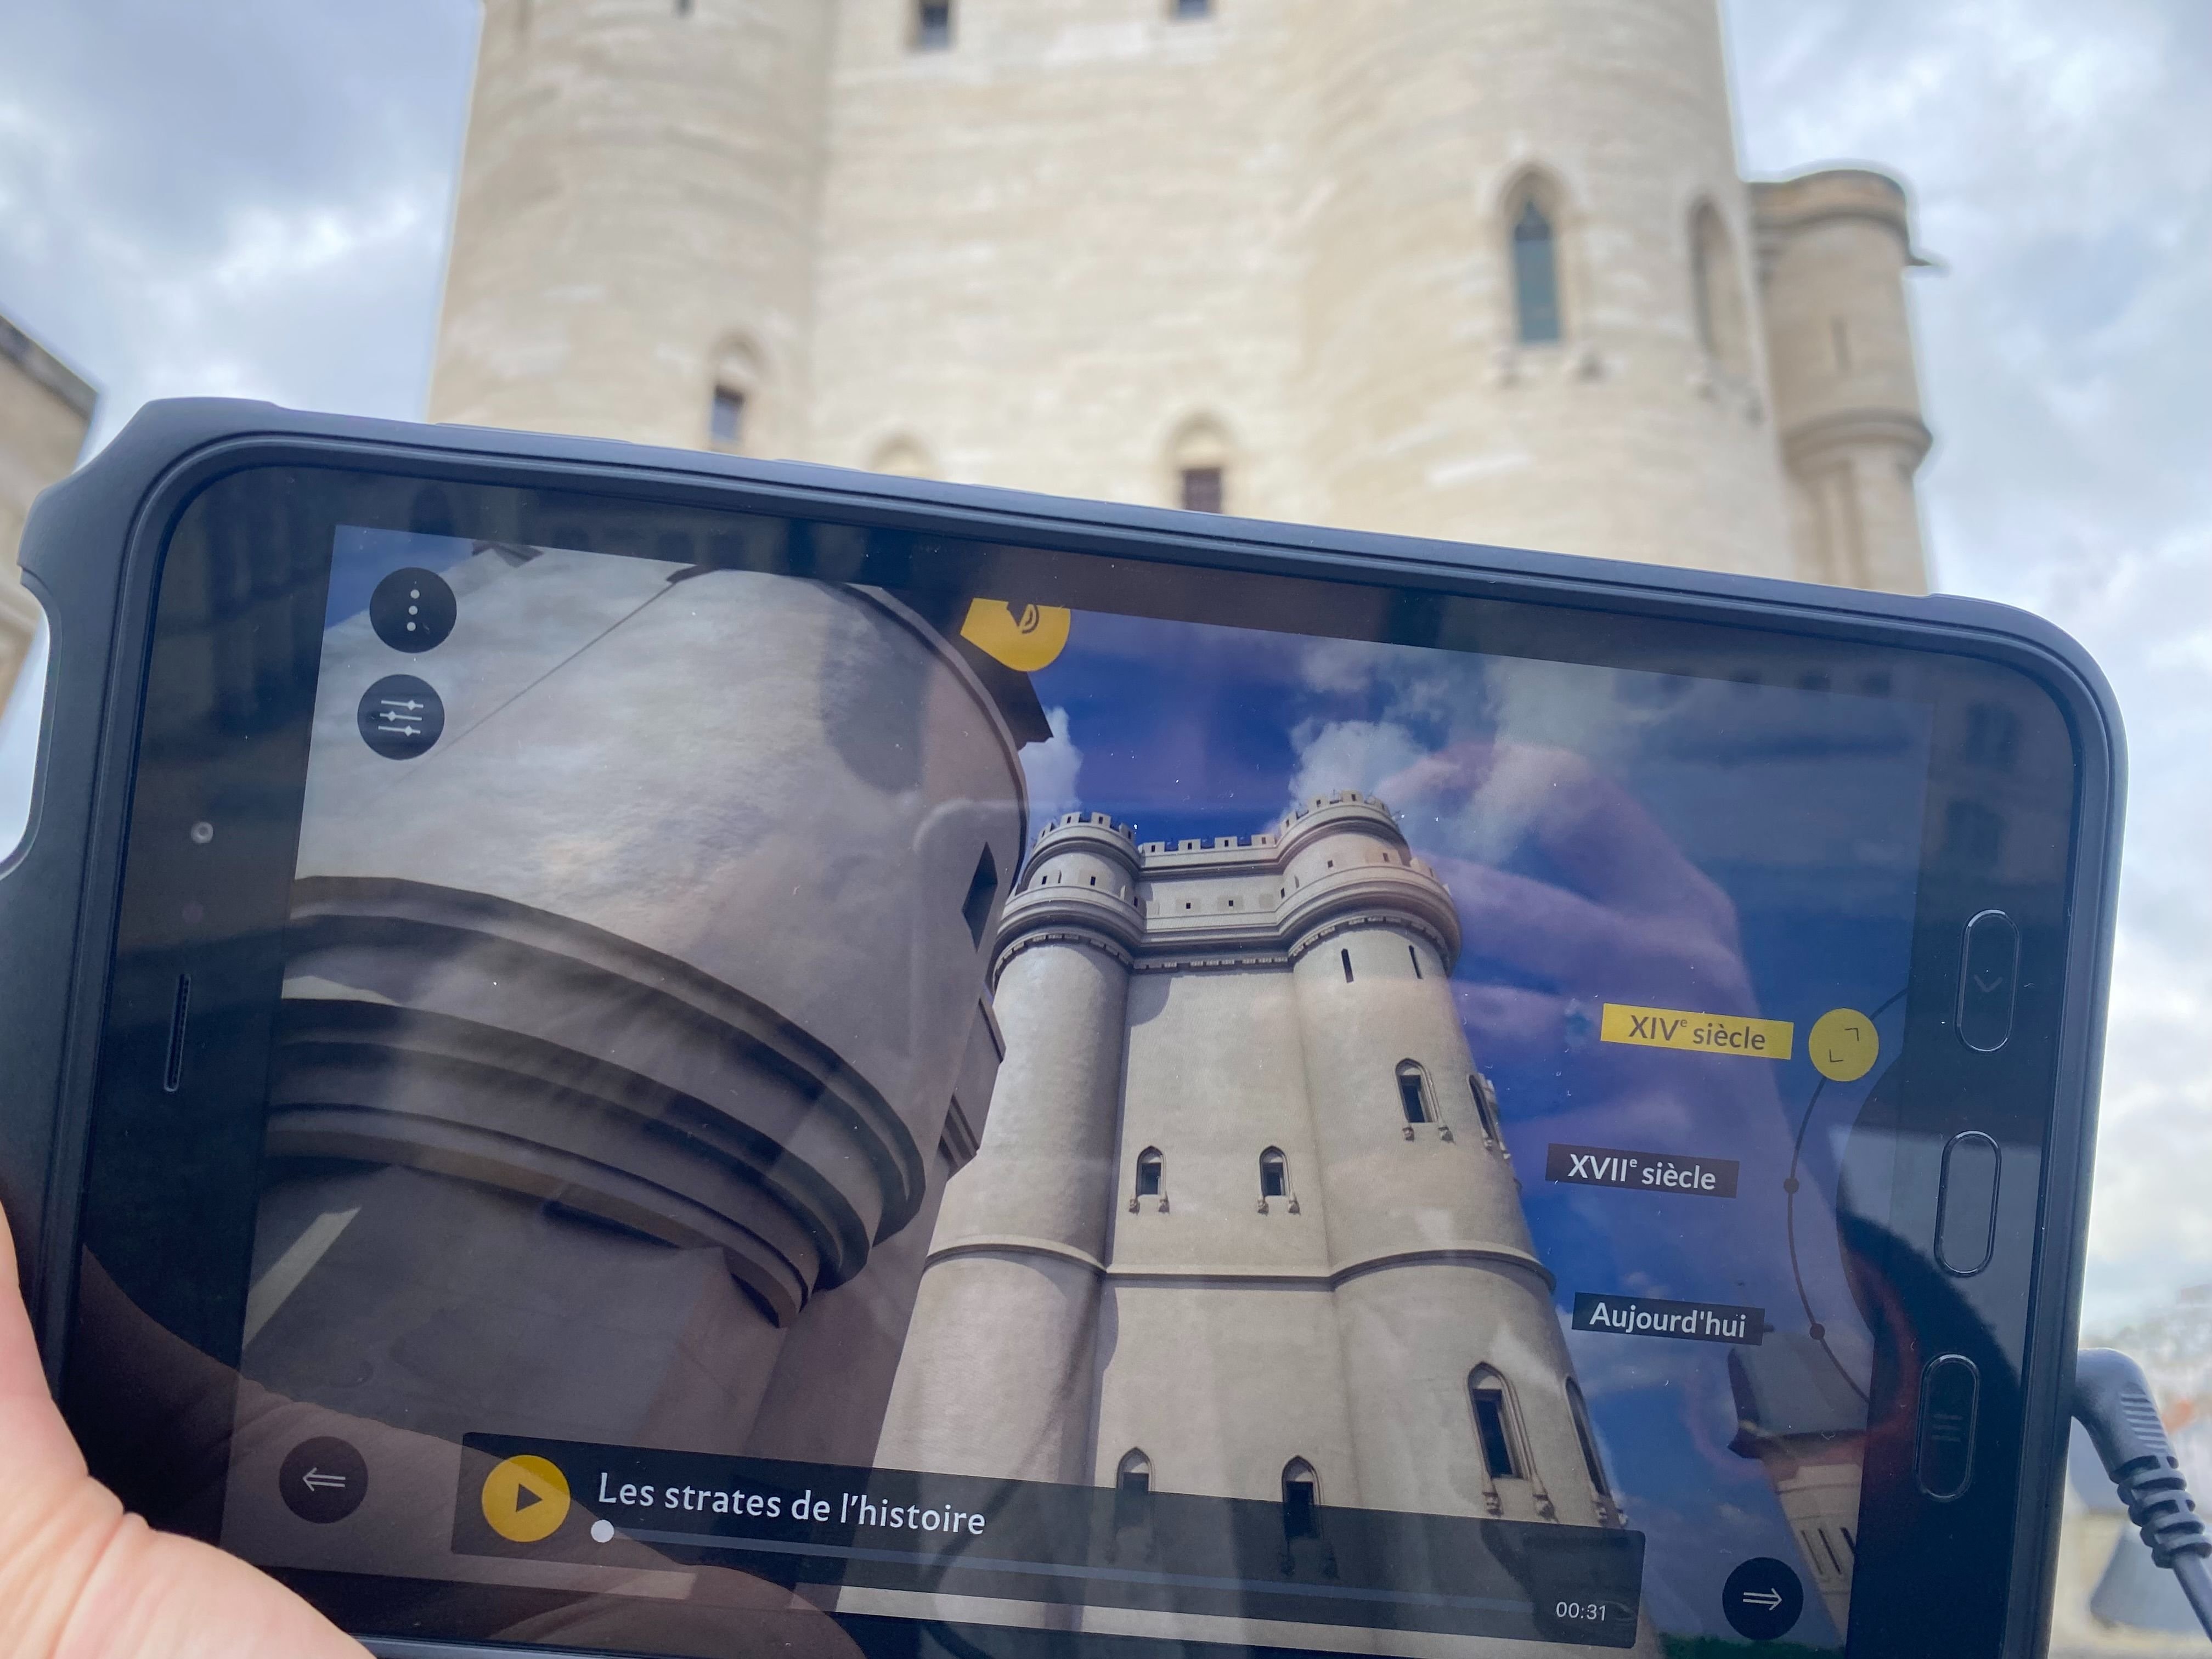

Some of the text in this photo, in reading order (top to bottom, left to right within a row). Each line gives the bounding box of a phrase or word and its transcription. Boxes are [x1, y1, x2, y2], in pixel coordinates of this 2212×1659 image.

[1692, 1024, 1766, 1050] siècle
[1641, 1161, 1716, 1190] siècle
[1589, 1302, 1746, 1338] Aujourd'hui
[599, 1472, 986, 1534] Les strates de l’histoire
[1556, 1601, 1606, 1621] 00:31
